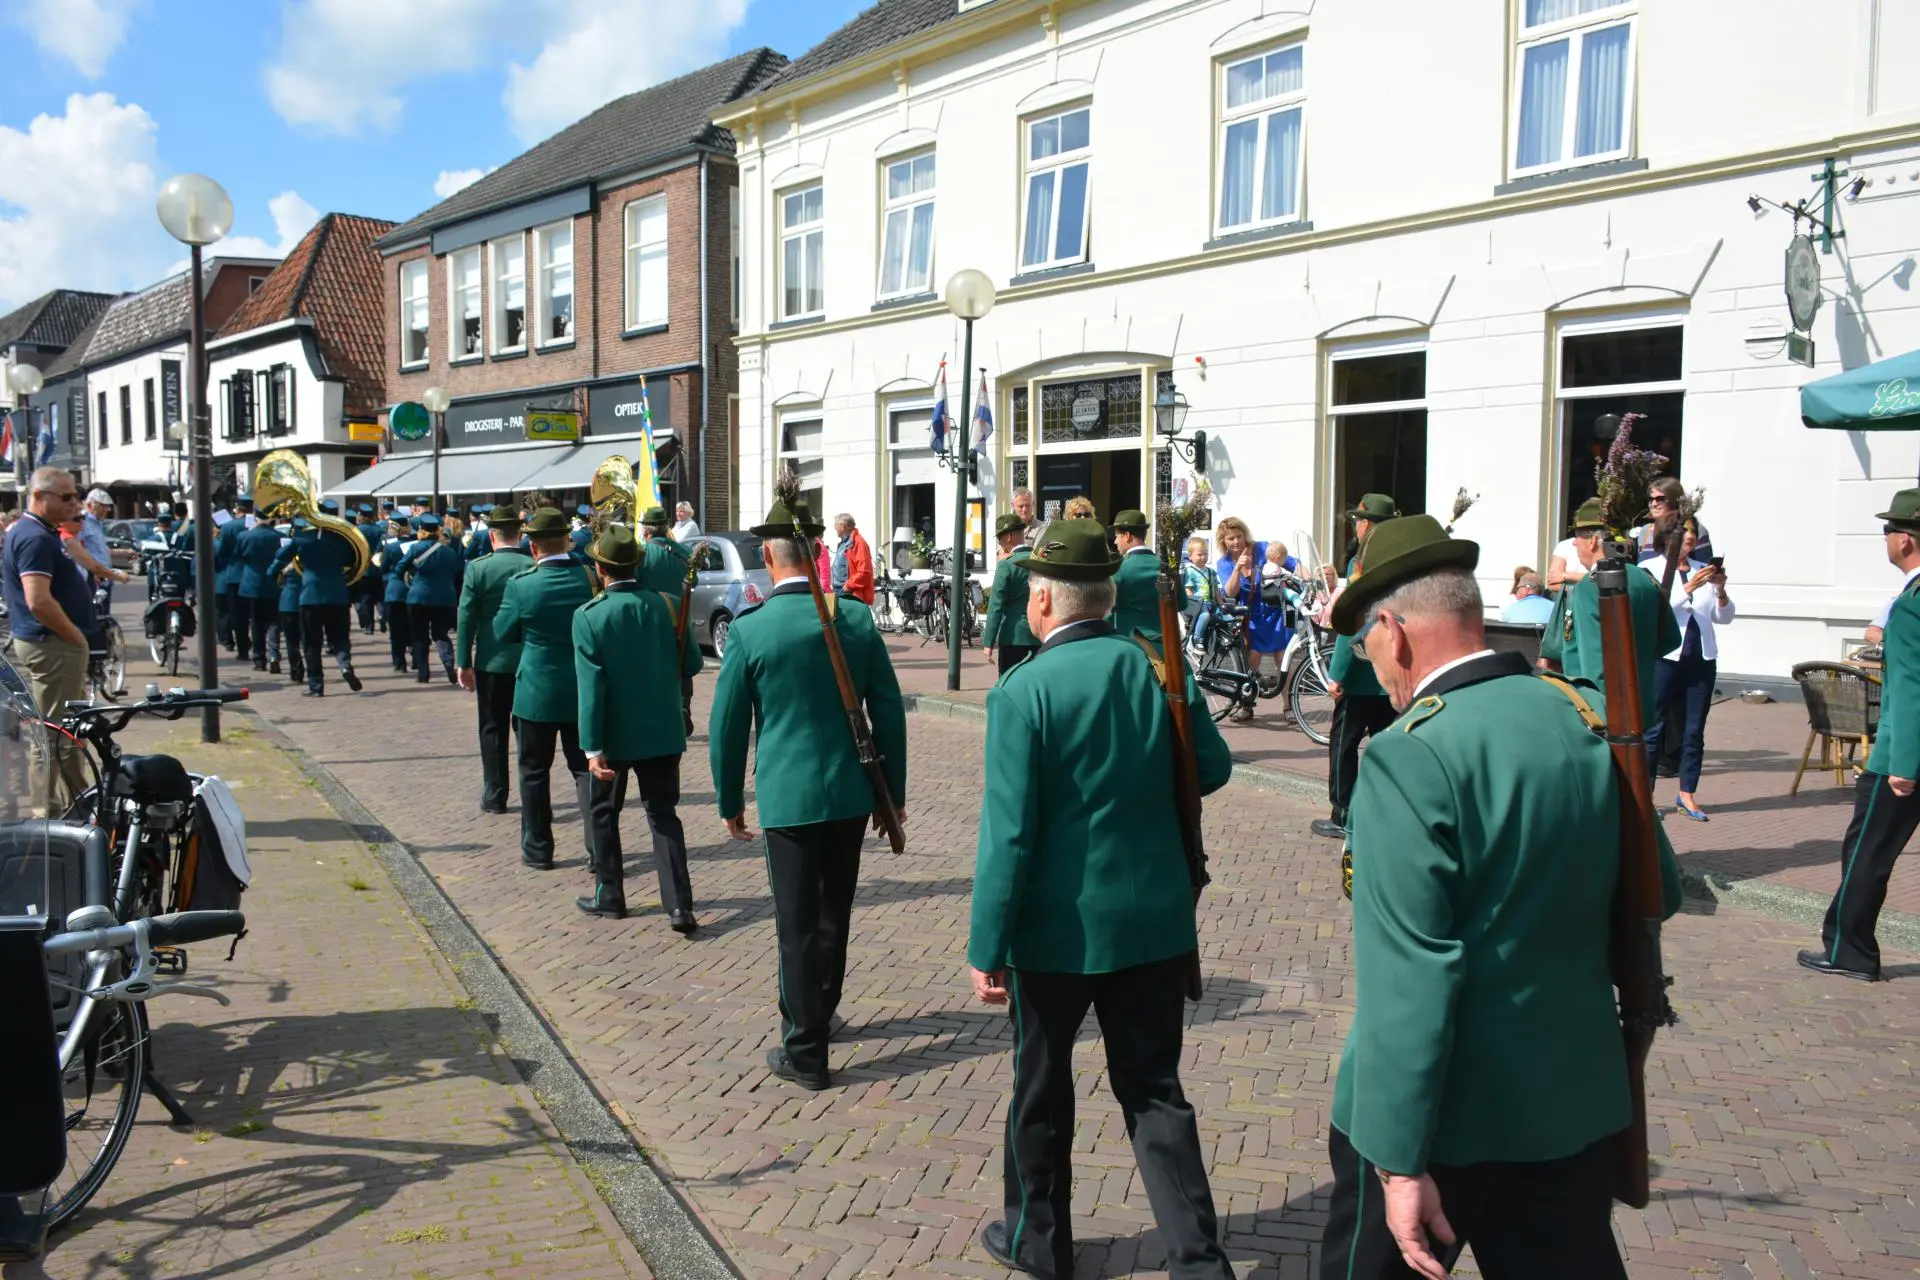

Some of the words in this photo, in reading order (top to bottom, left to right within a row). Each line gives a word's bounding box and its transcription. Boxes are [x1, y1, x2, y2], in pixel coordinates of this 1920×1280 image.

[166, 371, 178, 426] SLAPEN
[614, 402, 644, 417] OPTIEK
[73, 391, 85, 441] TEXTIEL
[464, 418, 503, 433] DROGISTERIJ
